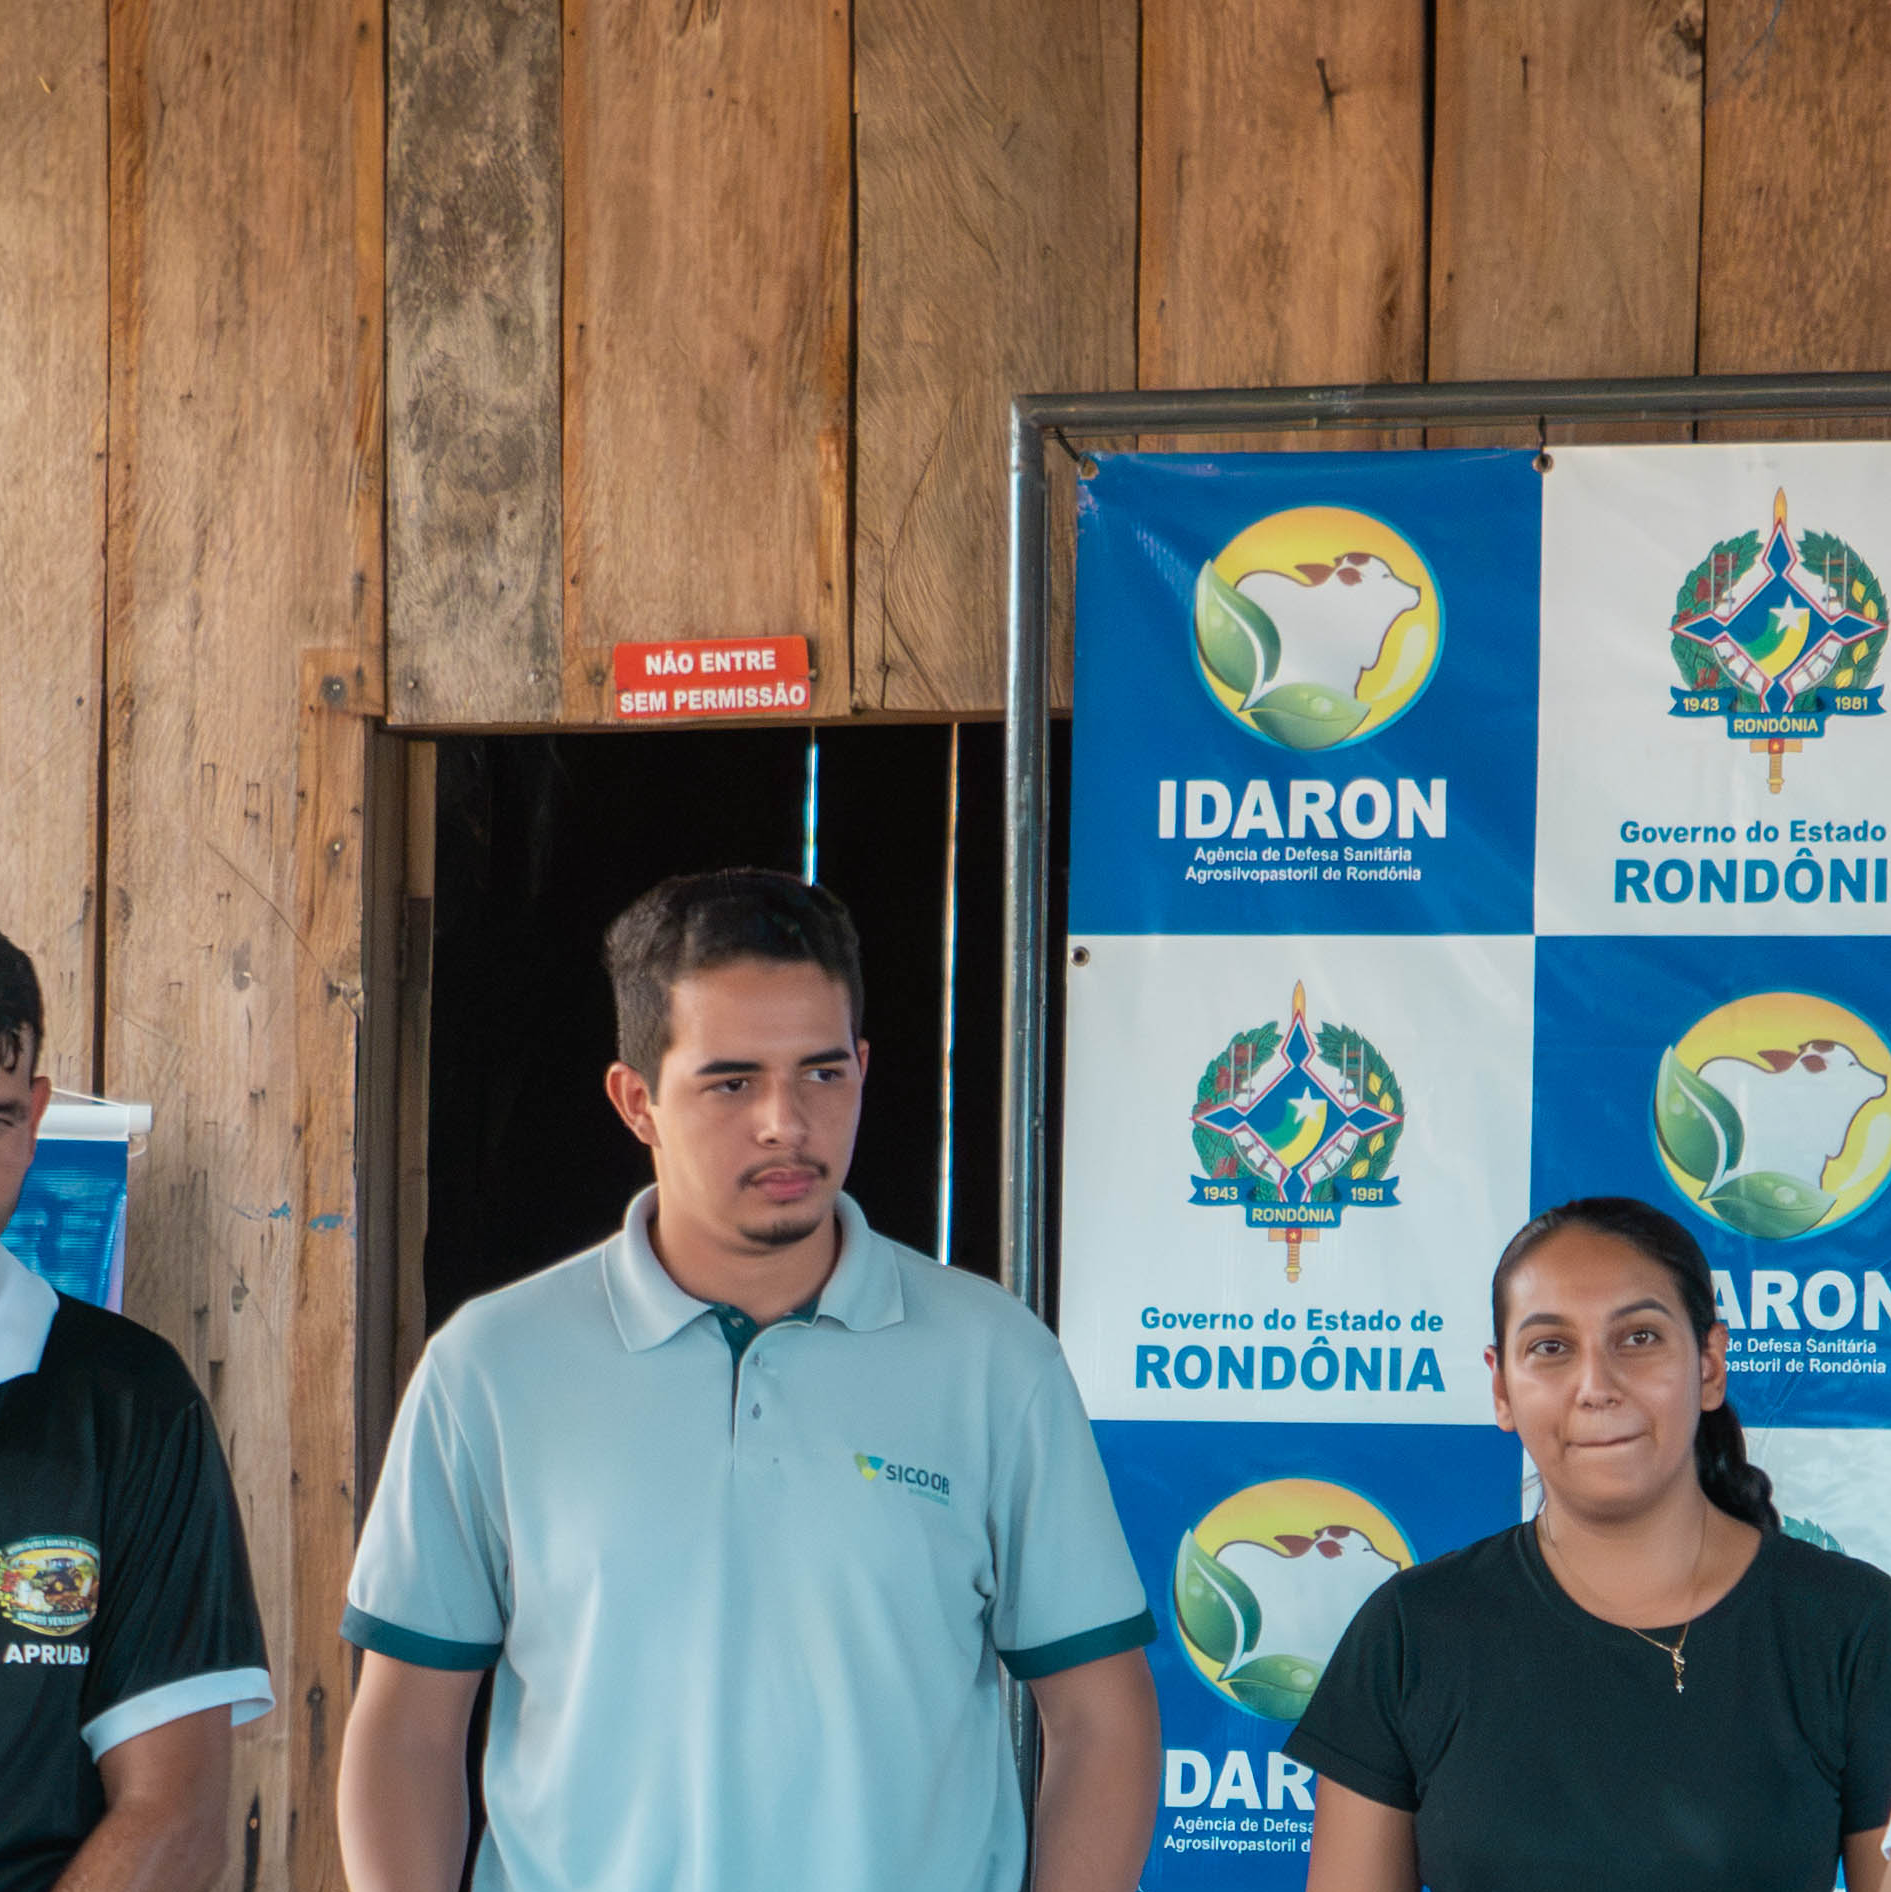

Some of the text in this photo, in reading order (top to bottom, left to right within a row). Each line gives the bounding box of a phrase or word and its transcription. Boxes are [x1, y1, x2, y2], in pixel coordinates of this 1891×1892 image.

[646, 650, 776, 675] NÃO ENTRE
[620, 682, 806, 713] SEM PERMISSÃO
[1683, 697, 1720, 711] 1943
[1835, 696, 1868, 711] 1981
[1733, 715, 1818, 733] RONDÔNIA
[1158, 778, 1448, 840] IDARON
[1619, 820, 1736, 844] Governo
[1744, 819, 1780, 842] do
[1789, 819, 1888, 843] Estado
[1194, 844, 1412, 866] Agência de Defesa Sanitária
[1185, 865, 1422, 886] Agrosilvopastoril de Rondônia
[1203, 1186, 1239, 1201] 1943
[1351, 1187, 1384, 1202] 1981
[1251, 1205, 1336, 1222] RONDÔNIA
[1140, 1306, 1444, 1333] Governo do Estado de
[1747, 1338, 1802, 1353] Defesa
[1806, 1337, 1877, 1354] Sanitária
[1135, 1337, 1446, 1393] RONDÔNIA
[1785, 1358, 1804, 1373] de
[1810, 1357, 1887, 1374] Rondônia
[1173, 1815, 1236, 1834] Agência
[1240, 1817, 1258, 1832] de
[1164, 1835, 1296, 1854] Agrosilvopastoril
